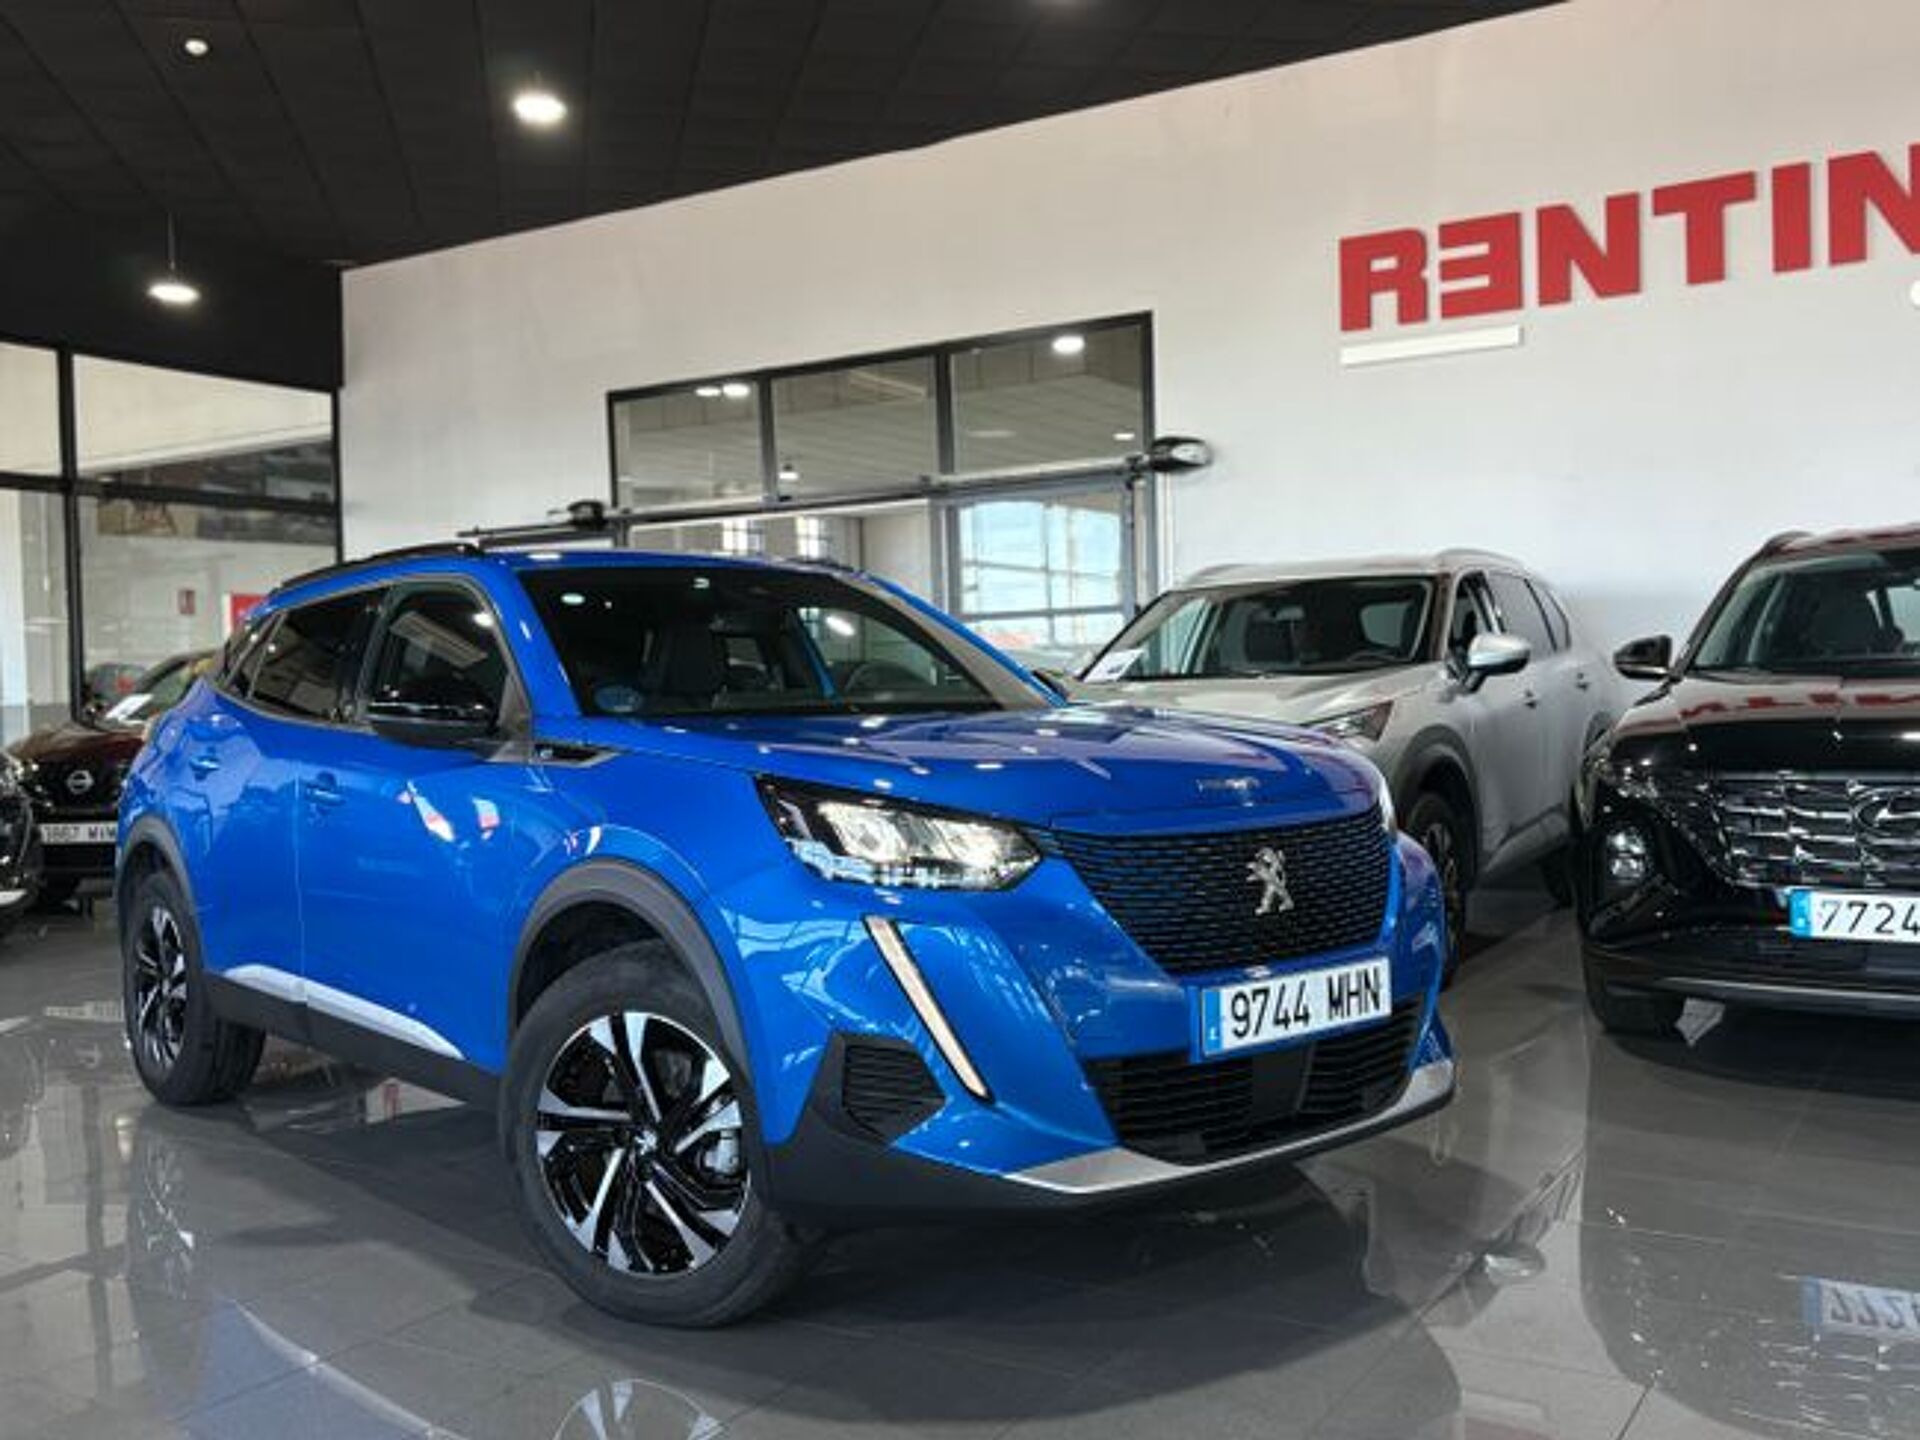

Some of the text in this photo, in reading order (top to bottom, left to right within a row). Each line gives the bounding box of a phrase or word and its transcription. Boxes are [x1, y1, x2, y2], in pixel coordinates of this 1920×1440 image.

[1339, 143, 1920, 332] RENTIN
[1821, 899, 1920, 935] 7724
[1231, 966, 1381, 1039] 9744 MHN
